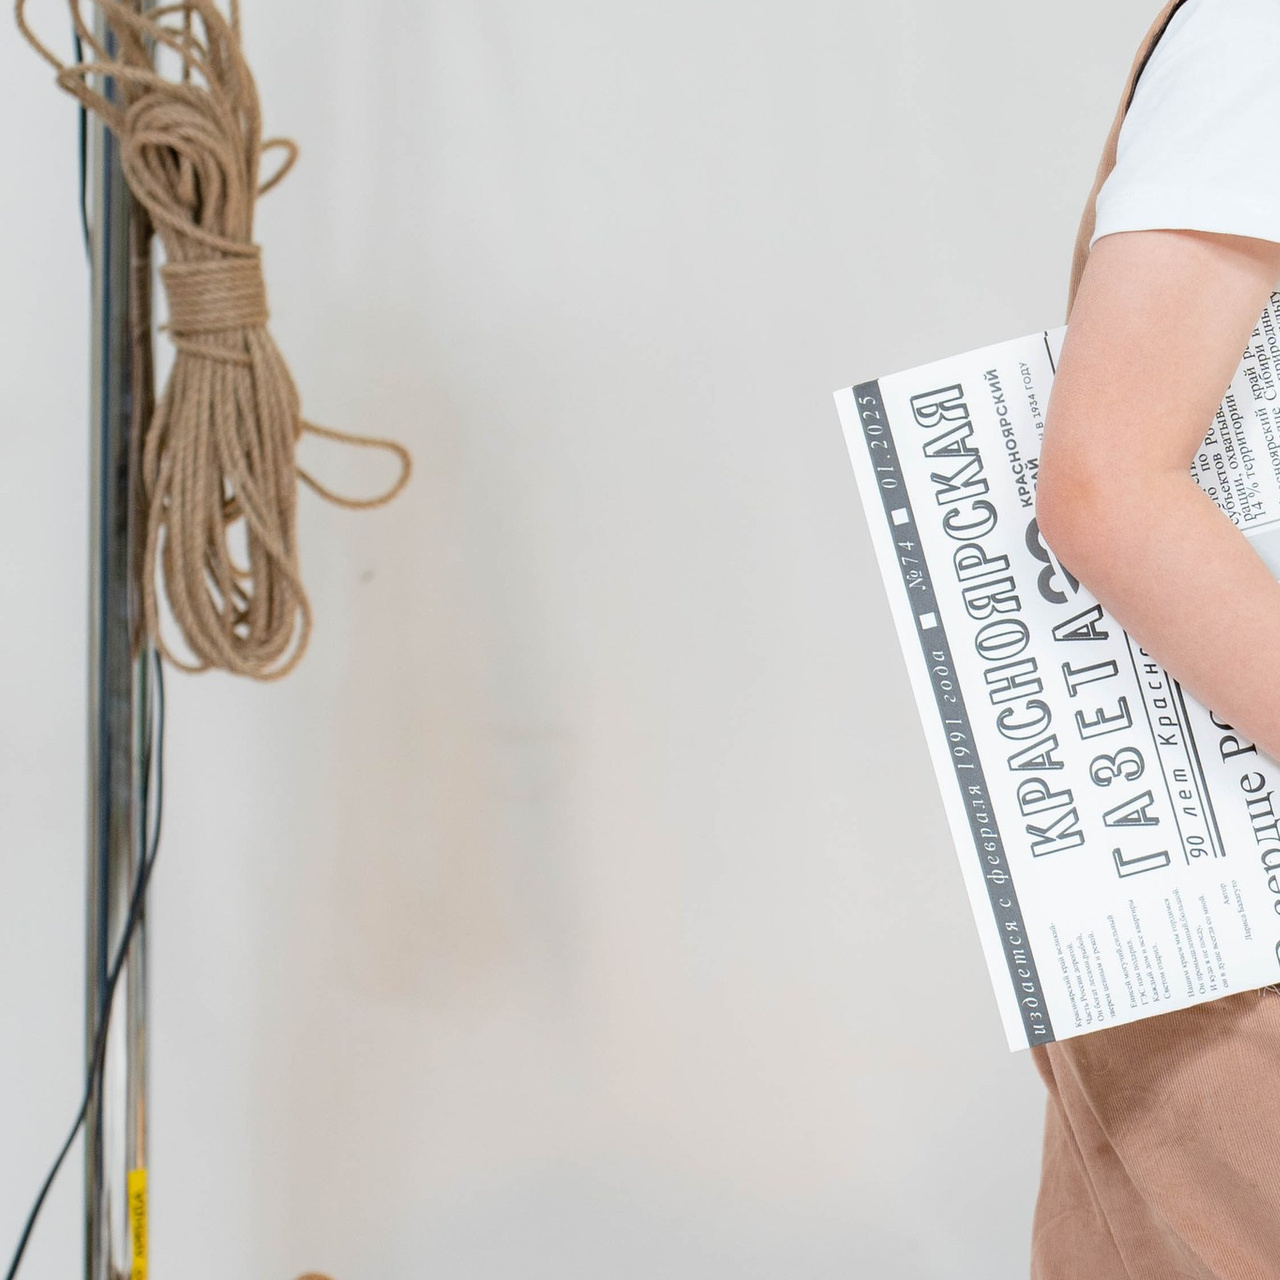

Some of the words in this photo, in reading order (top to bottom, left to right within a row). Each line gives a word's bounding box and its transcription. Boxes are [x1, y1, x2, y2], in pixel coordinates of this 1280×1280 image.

[1019, 362, 1033, 390] ГОДУ
[1243, 366, 1267, 401] край
[1028, 393, 1041, 418] 1934
[1035, 421, 1044, 429] В
[858, 396, 898, 489] 01.2025
[983, 369, 1033, 508] КРАСНОЯРСКИЙ
[898, 541, 926, 591] №74
[909, 383, 1086, 858] КРАСНОЯРСКАЯ
[932, 651, 956, 703] года
[945, 719, 975, 769] 1991
[1051, 603, 1171, 879] ГАЗЕТА
[1172, 769, 1198, 817] лет
[968, 784, 1009, 884] февраля
[1186, 835, 1209, 858] 90
[999, 898, 1012, 908] с
[1005, 920, 1046, 1035] издается
